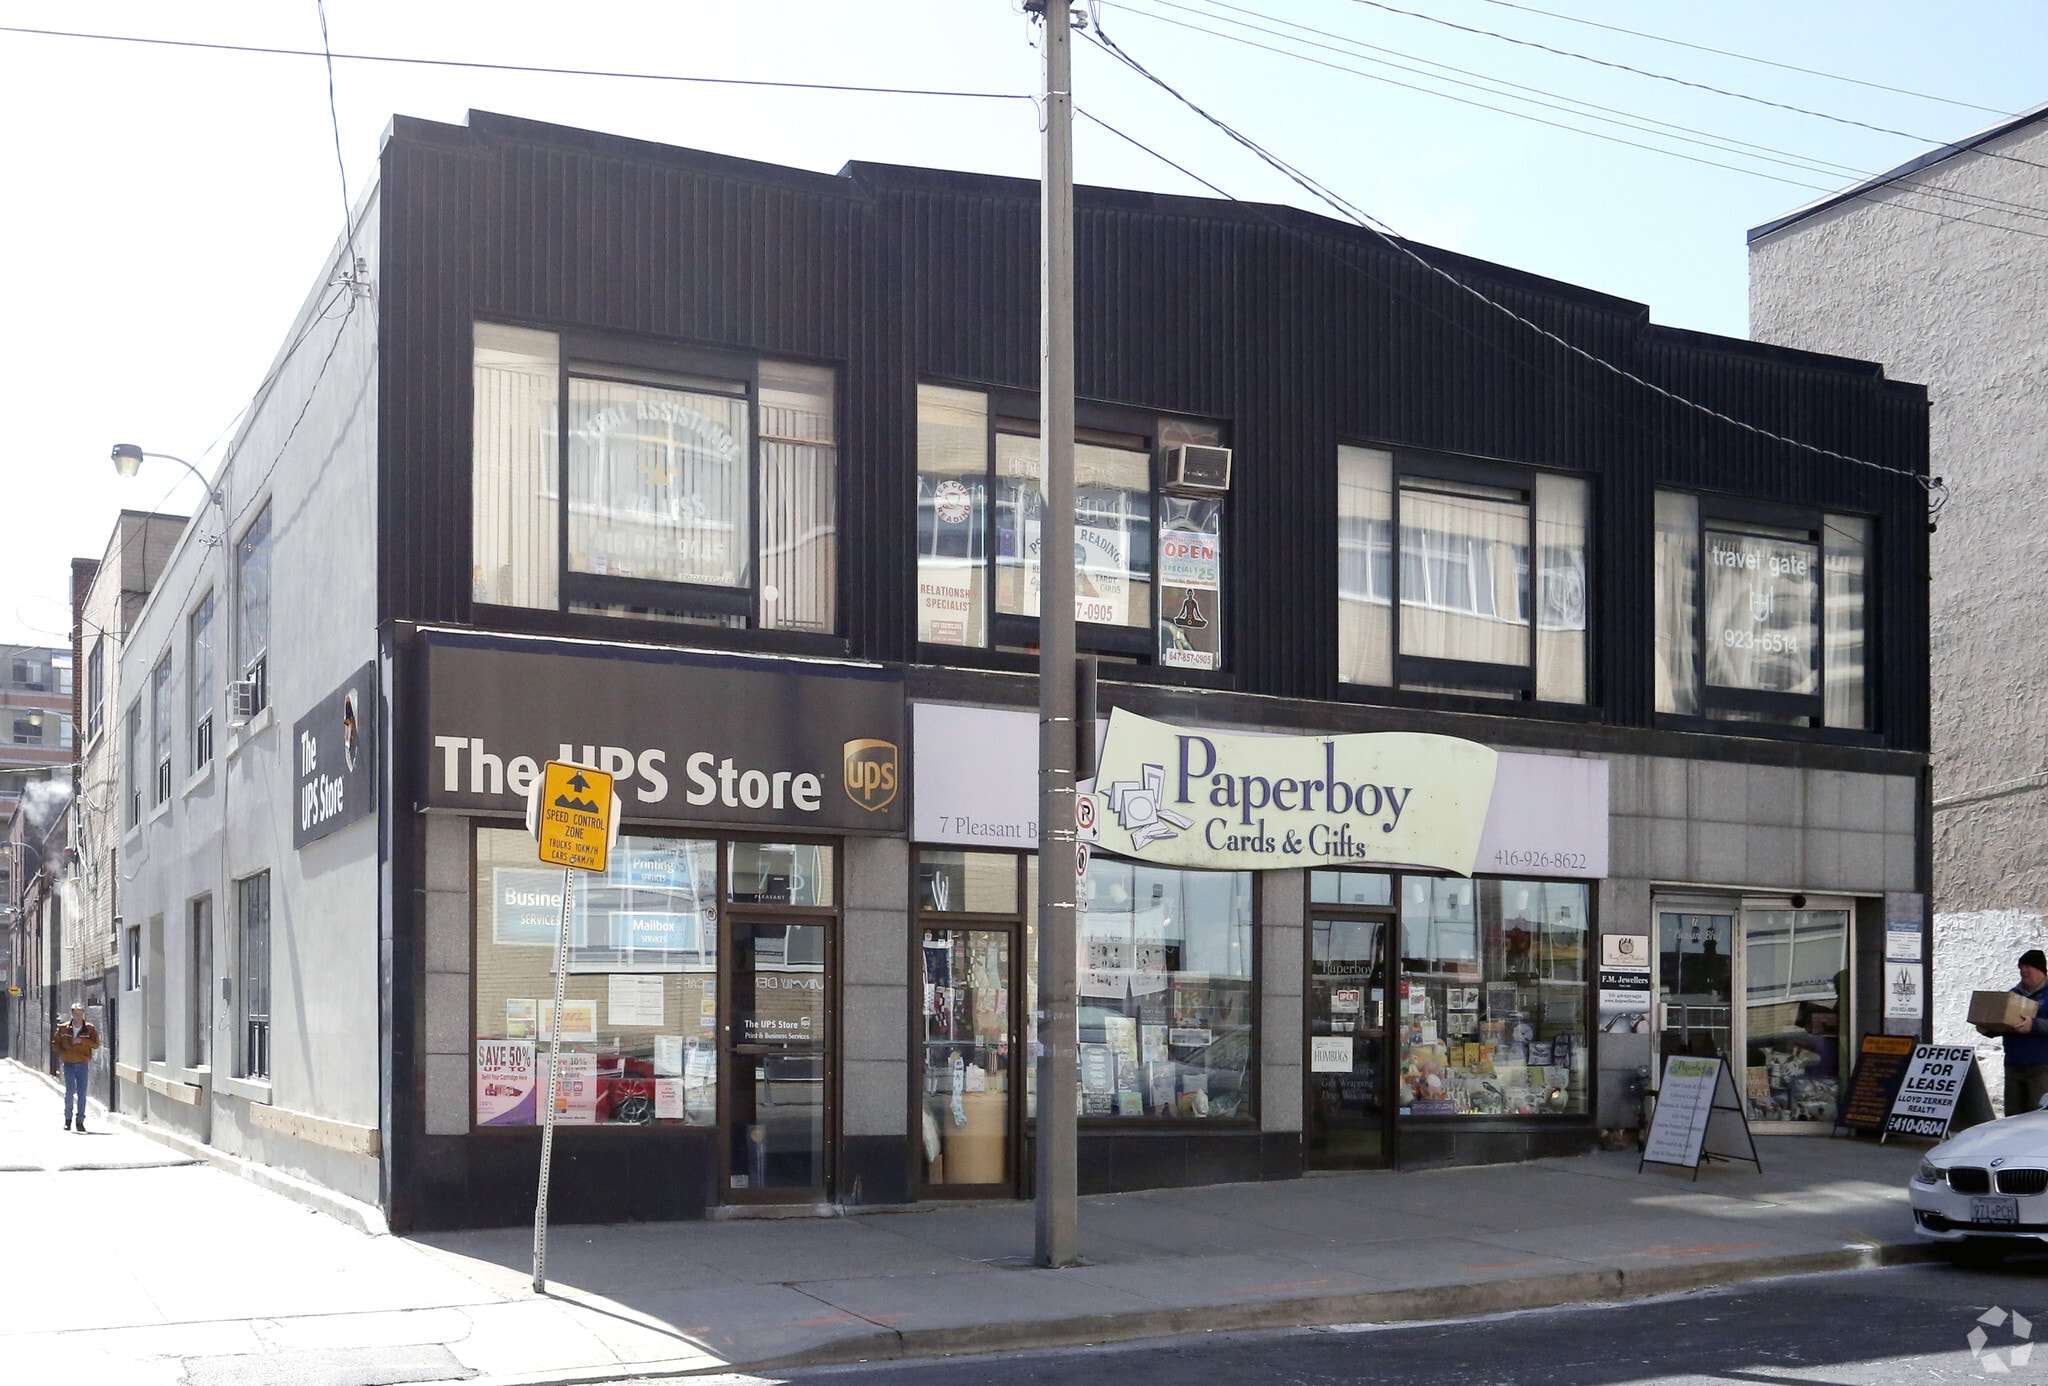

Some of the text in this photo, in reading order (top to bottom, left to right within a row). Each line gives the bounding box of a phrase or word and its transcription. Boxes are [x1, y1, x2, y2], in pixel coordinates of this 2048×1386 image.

[935, 481, 968, 498] TEA CUP
[936, 504, 971, 524] READING
[1164, 541, 1214, 560] OPEN
[1712, 546, 1808, 577] travel gate
[1095, 574, 1118, 584] TAROT
[1100, 584, 1121, 594] CARDS
[926, 597, 973, 612] SPECIALIST
[1724, 629, 1798, 653] 923-6514
[301, 729, 317, 778] The
[434, 735, 540, 799] The
[686, 751, 823, 812] Store
[848, 761, 895, 800] ups
[1174, 735, 1413, 834] Paperboy
[301, 772, 344, 831] UPS Store
[546, 808, 605, 831] SPEED CONTROL
[939, 816, 949, 834] 7
[955, 816, 1022, 838] Pleasant
[565, 825, 584, 840] ZONE
[1205, 817, 1367, 859] Cards & Gifts
[549, 838, 599, 856] TRUCKS 10KM/H
[552, 850, 568, 861] CARS
[1494, 849, 1587, 870] 416-926-8622
[633, 859, 675, 873] Printing
[641, 874, 666, 882] SERVICES
[520, 913, 562, 926] SERVICES
[633, 919, 675, 932] Mailbox
[641, 936, 667, 944] SERVICES
[1601, 975, 1649, 985] F.M. Jewellers
[744, 1020, 758, 1028] The
[761, 1020, 776, 1029] UPS
[779, 1020, 799, 1029] Store
[478, 1045, 531, 1067] SAVE 50%
[1314, 1050, 1349, 1063] HUMBUGS
[1915, 1046, 1971, 1062] OFFICE
[1921, 1063, 1954, 1076] FOR
[1906, 1077, 1957, 1093] LEASE
[1898, 1095, 1953, 1107] LLOYD ZERKER
[1907, 1105, 1937, 1114] REALTY
[1893, 1117, 1945, 1136] 410-0604
